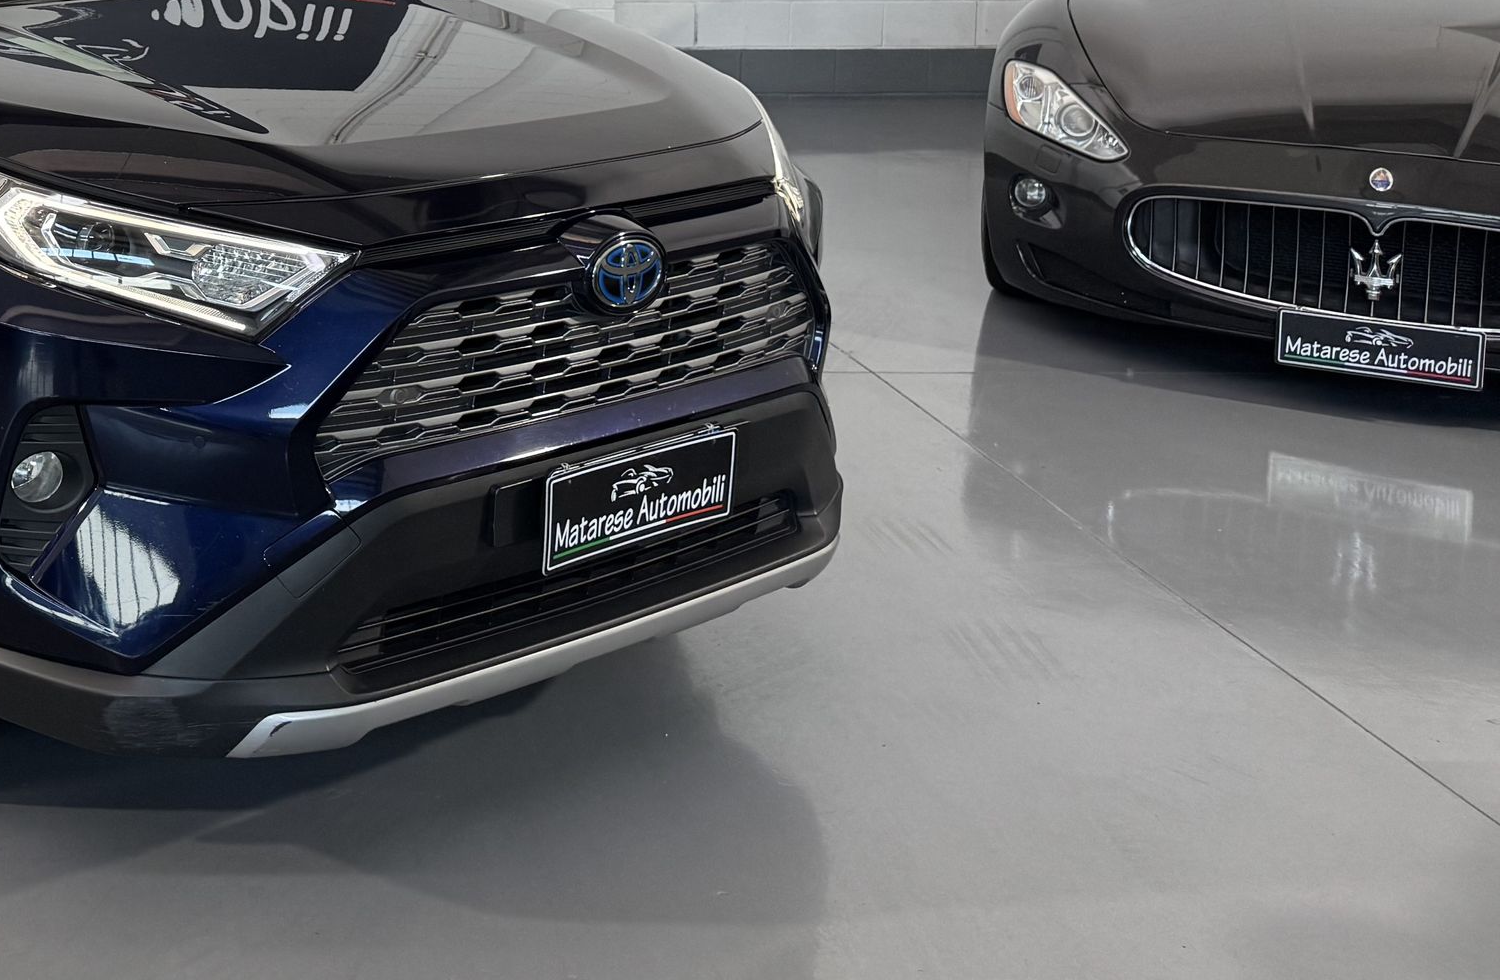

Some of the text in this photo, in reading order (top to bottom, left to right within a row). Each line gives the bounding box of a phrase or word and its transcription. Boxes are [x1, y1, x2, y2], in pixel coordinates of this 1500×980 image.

[1285, 335, 1473, 378] Matarese Automobili
[554, 474, 726, 552] Matarese Automobili
